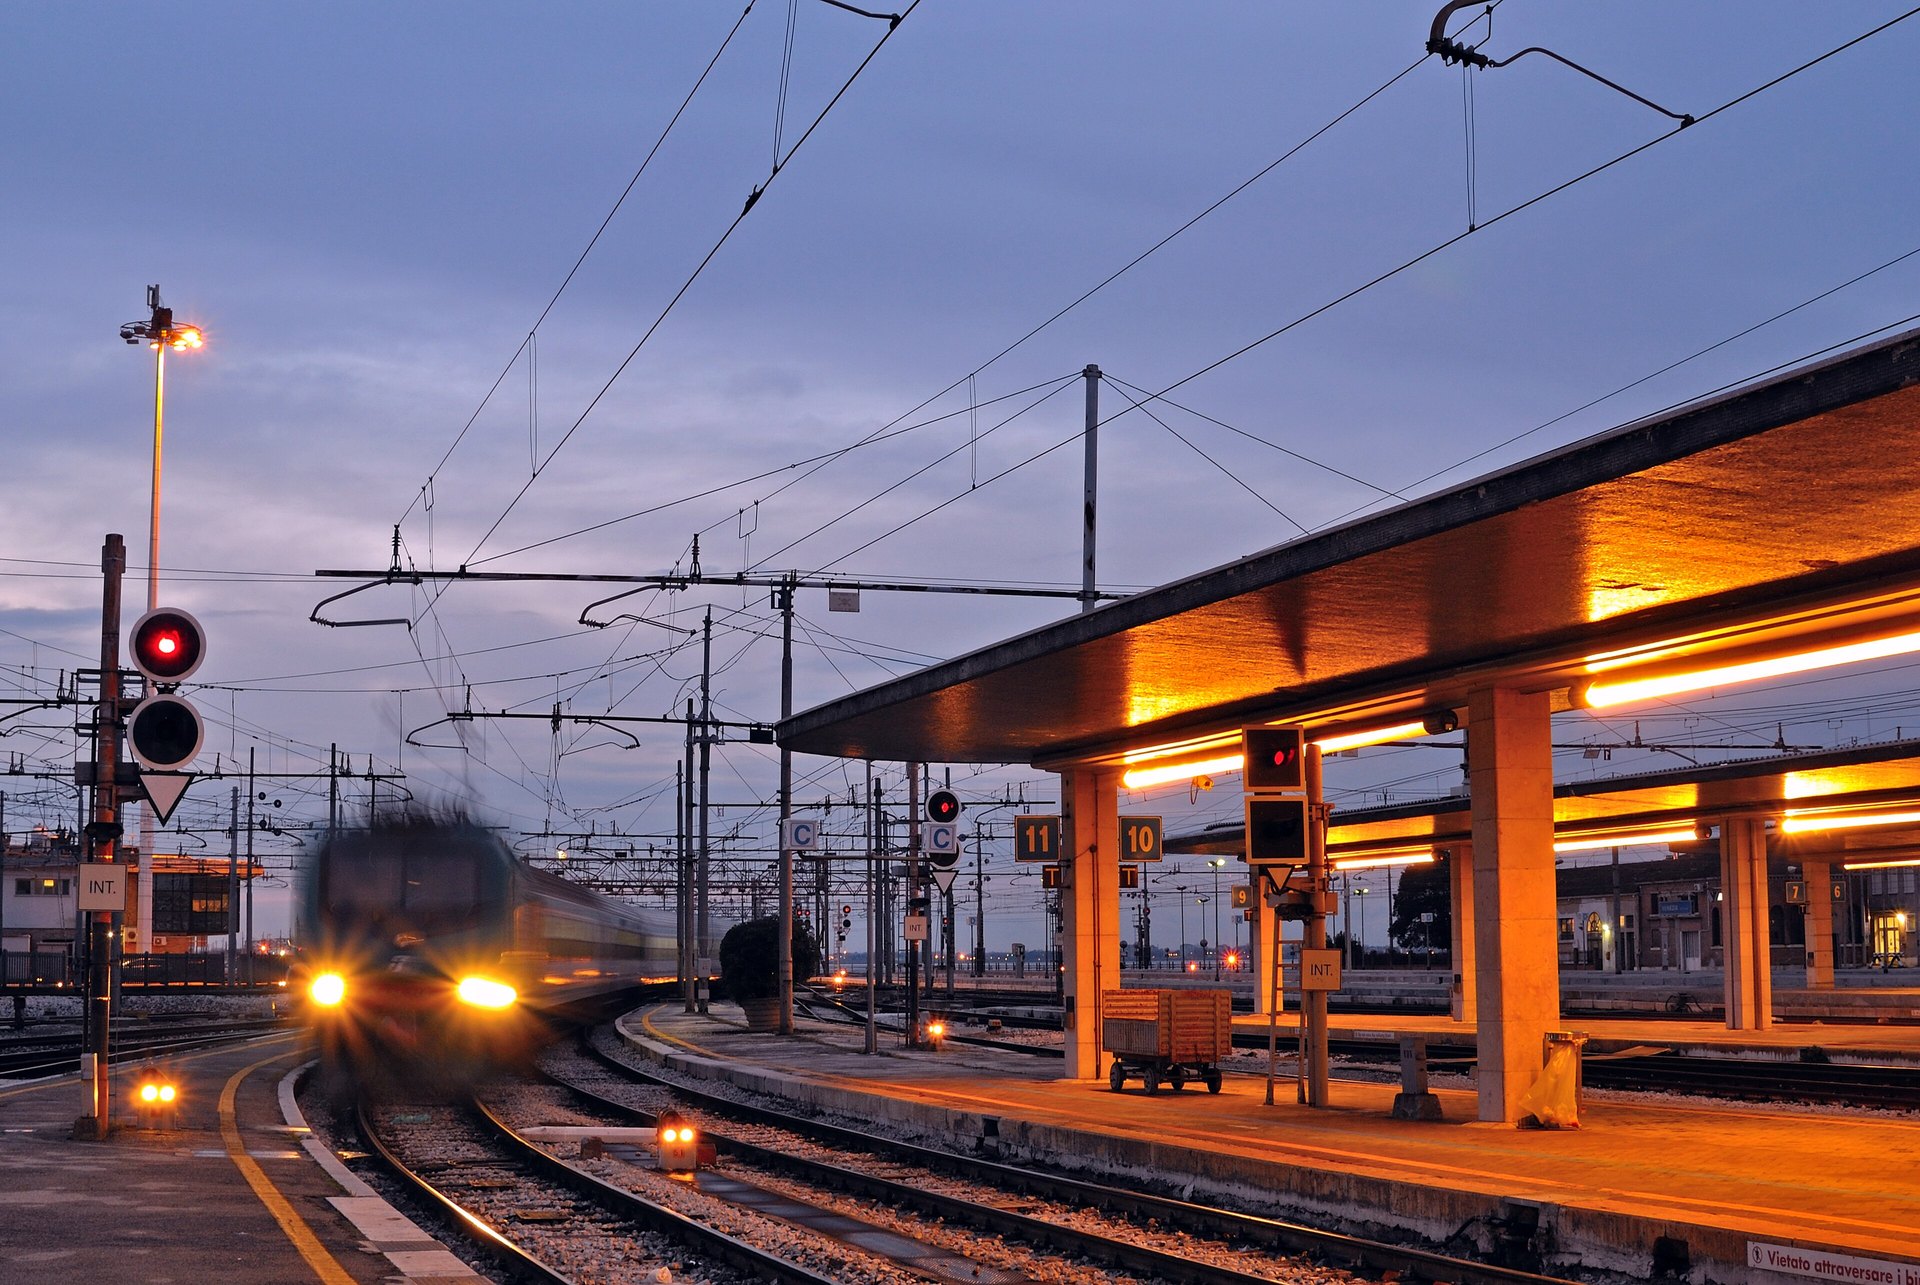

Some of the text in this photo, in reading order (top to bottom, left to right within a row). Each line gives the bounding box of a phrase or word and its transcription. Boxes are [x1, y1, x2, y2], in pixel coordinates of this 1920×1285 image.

[794, 824, 811, 845] C
[933, 828, 950, 849] C
[1026, 825, 1049, 853] 11
[1128, 825, 1154, 853] 10
[1045, 868, 1060, 886] T
[1121, 868, 1136, 886] T
[89, 880, 116, 894] INT.
[1792, 885, 1799, 899] 7
[1834, 885, 1841, 898] 6
[1239, 890, 1246, 904] 9
[909, 924, 923, 932] INT.
[1310, 964, 1333, 976] INT.
[1767, 1250, 1811, 1271] Vietato
[1814, 1259, 1894, 1283] attraversare
[1897, 1268, 1901, 1285] i
